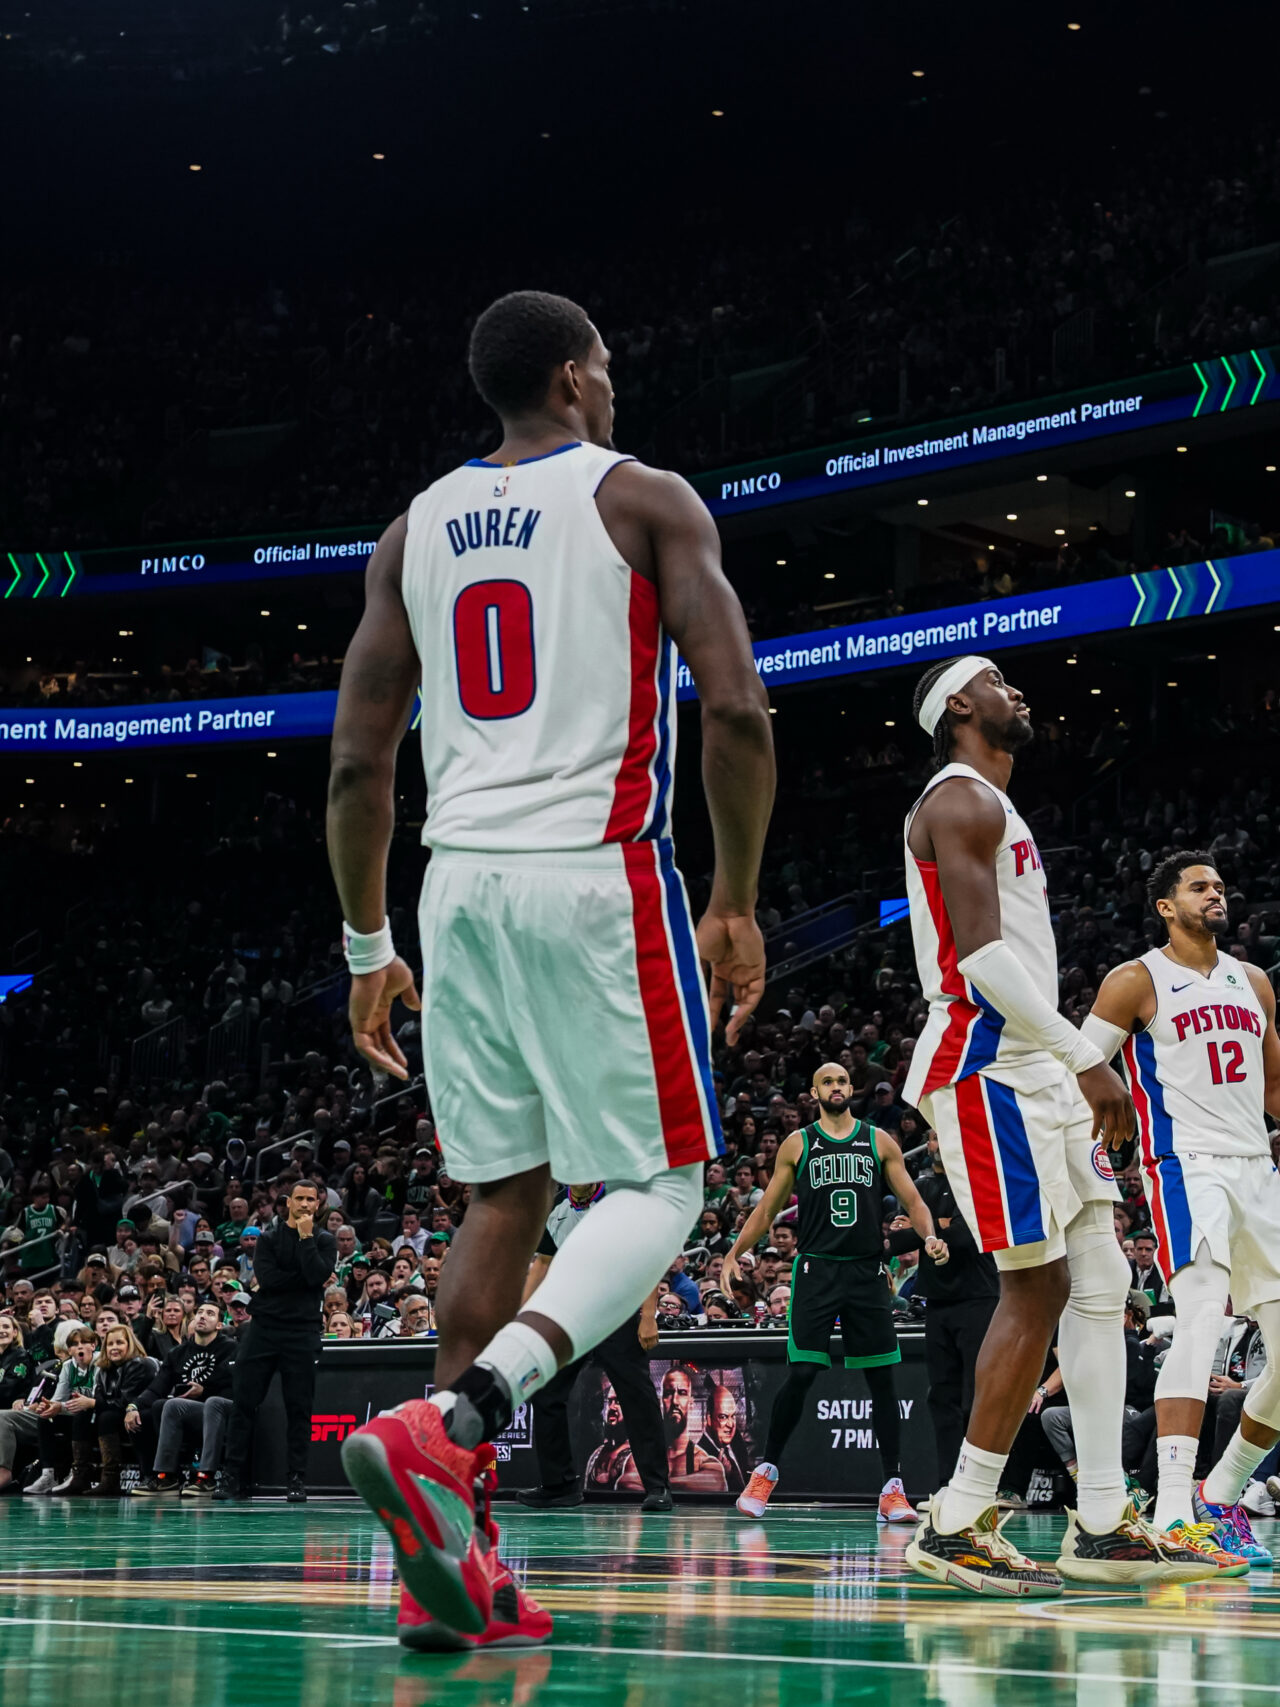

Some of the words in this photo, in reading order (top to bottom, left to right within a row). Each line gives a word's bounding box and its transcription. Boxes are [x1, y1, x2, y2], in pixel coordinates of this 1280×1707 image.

[825, 449, 880, 477] Official
[883, 431, 968, 465] Investment
[973, 408, 1077, 446] Management
[1081, 395, 1142, 423] Partner
[721, 472, 781, 500] PIMCO
[446, 506, 541, 557] DUREN
[141, 554, 205, 575] PIMCO
[254, 543, 311, 565] Official
[315, 540, 377, 559] Investm
[453, 578, 537, 721] 0
[754, 640, 841, 675] vestment
[846, 617, 977, 660] Management
[984, 603, 1062, 635] Partner
[54, 712, 192, 742] Management
[198, 709, 275, 731] Partner
[1171, 1004, 1262, 1043] PISTONS
[1207, 1040, 1247, 1085] 12
[809, 1153, 874, 1190] CELTICS
[830, 1189, 857, 1227] 9
[831, 1429, 841, 1449] 7
[845, 1429, 872, 1449] PM
